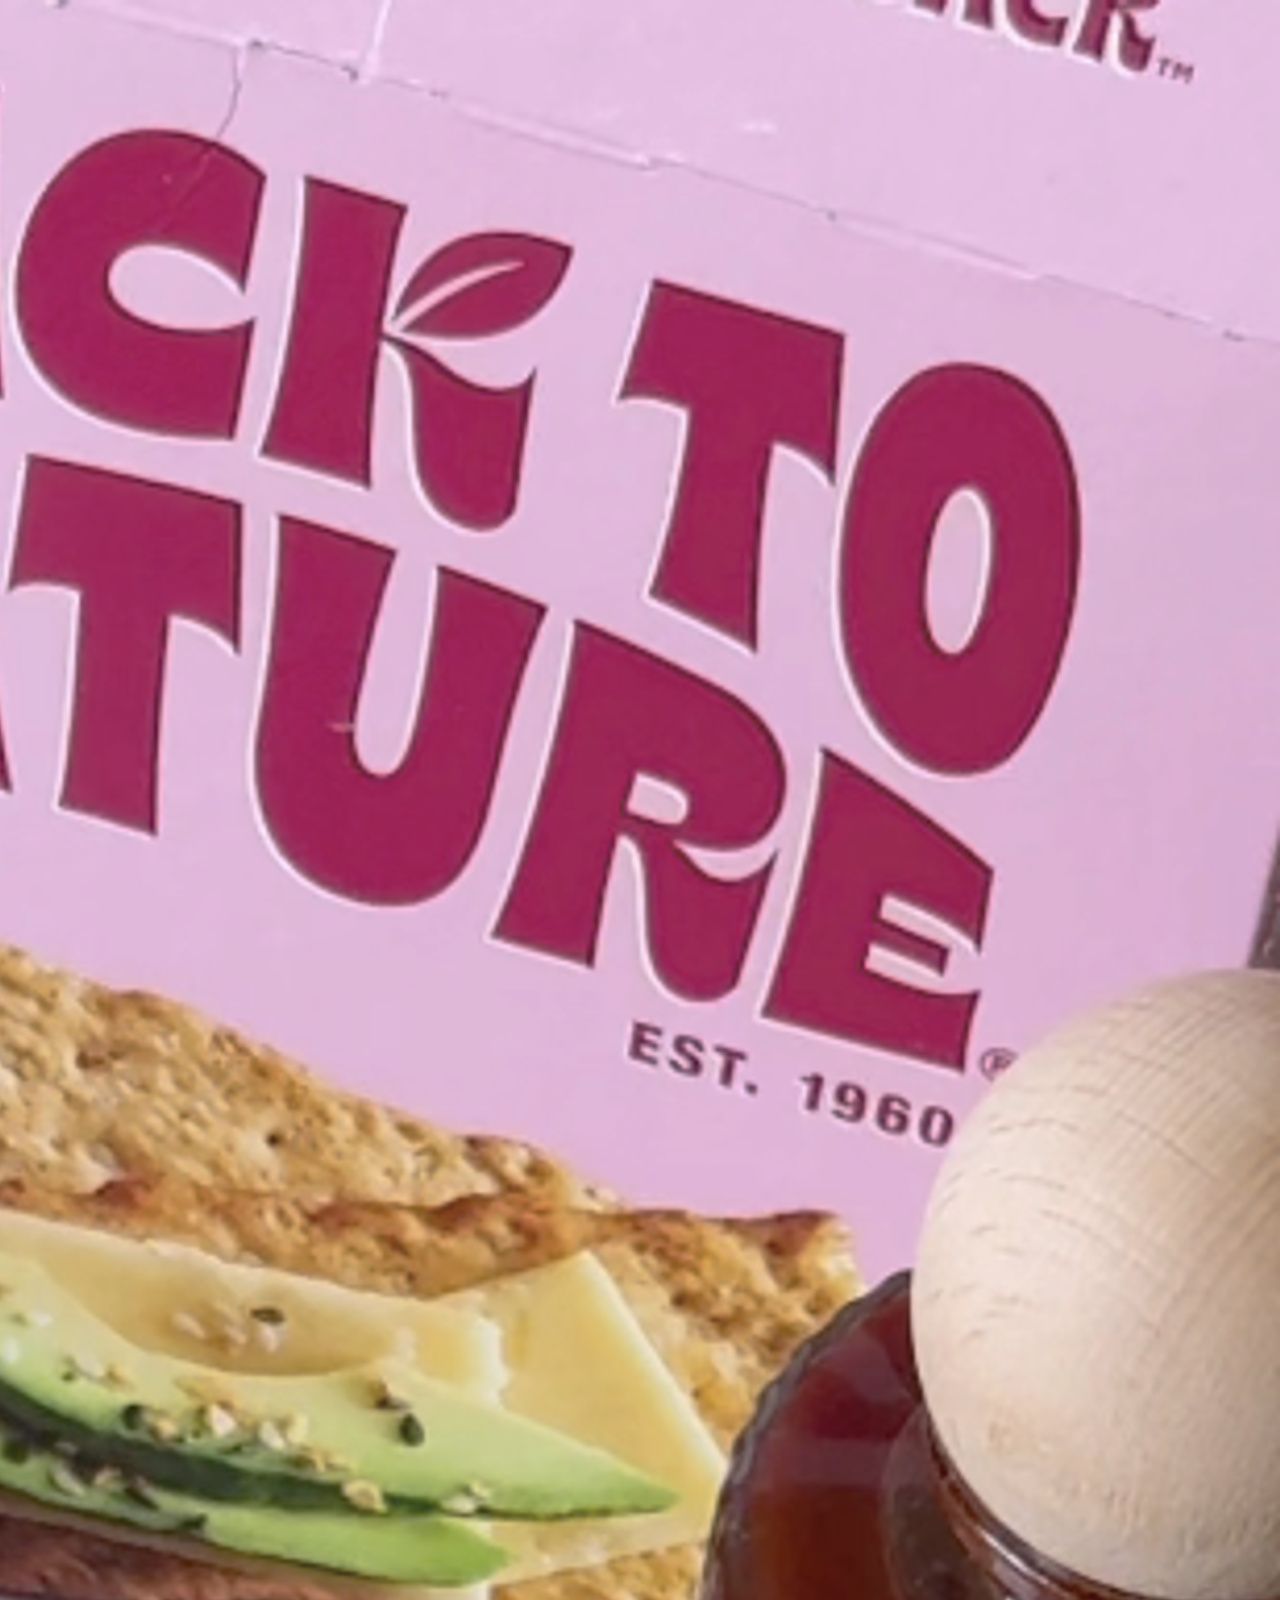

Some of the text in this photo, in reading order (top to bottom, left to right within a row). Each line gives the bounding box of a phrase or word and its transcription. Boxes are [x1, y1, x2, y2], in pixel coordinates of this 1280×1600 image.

[618, 279, 1082, 778] TO
[627, 1020, 955, 1147] EST. 1960
